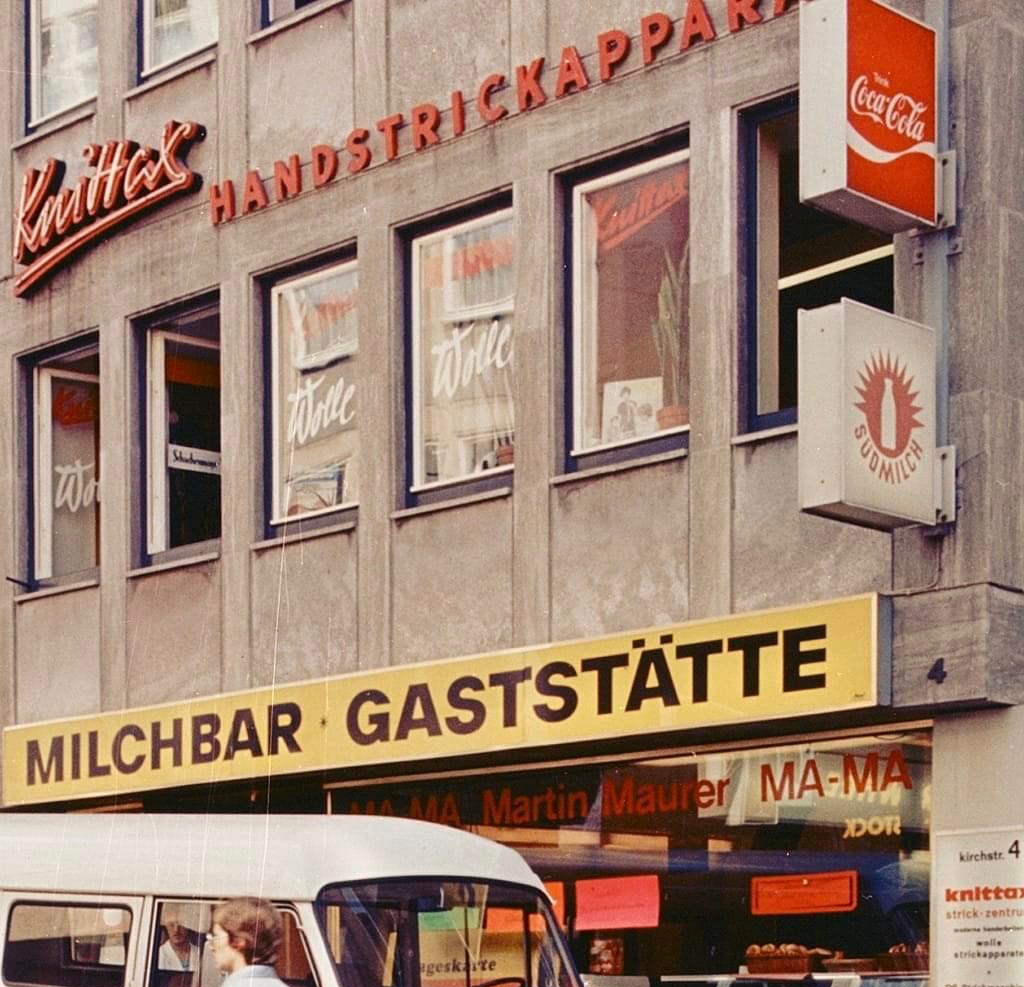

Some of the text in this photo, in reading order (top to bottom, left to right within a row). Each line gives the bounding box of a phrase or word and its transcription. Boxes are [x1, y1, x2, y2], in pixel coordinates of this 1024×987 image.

[209, 0, 788, 226] HANDSTRICKAPPAR
[850, 75, 928, 141] Coca-Cola
[287, 375, 355, 444] Wolle
[346, 623, 828, 746] GASTSTÄTTE
[926, 657, 948, 685] 4
[26, 701, 303, 787] MILCHBAR
[482, 784, 589, 827] Martin
[602, 773, 731, 817] Maurer
[760, 748, 914, 802] MA-MA
[959, 839, 1021, 863] kirchstr. 4
[976, 938, 1002, 947] wolle
